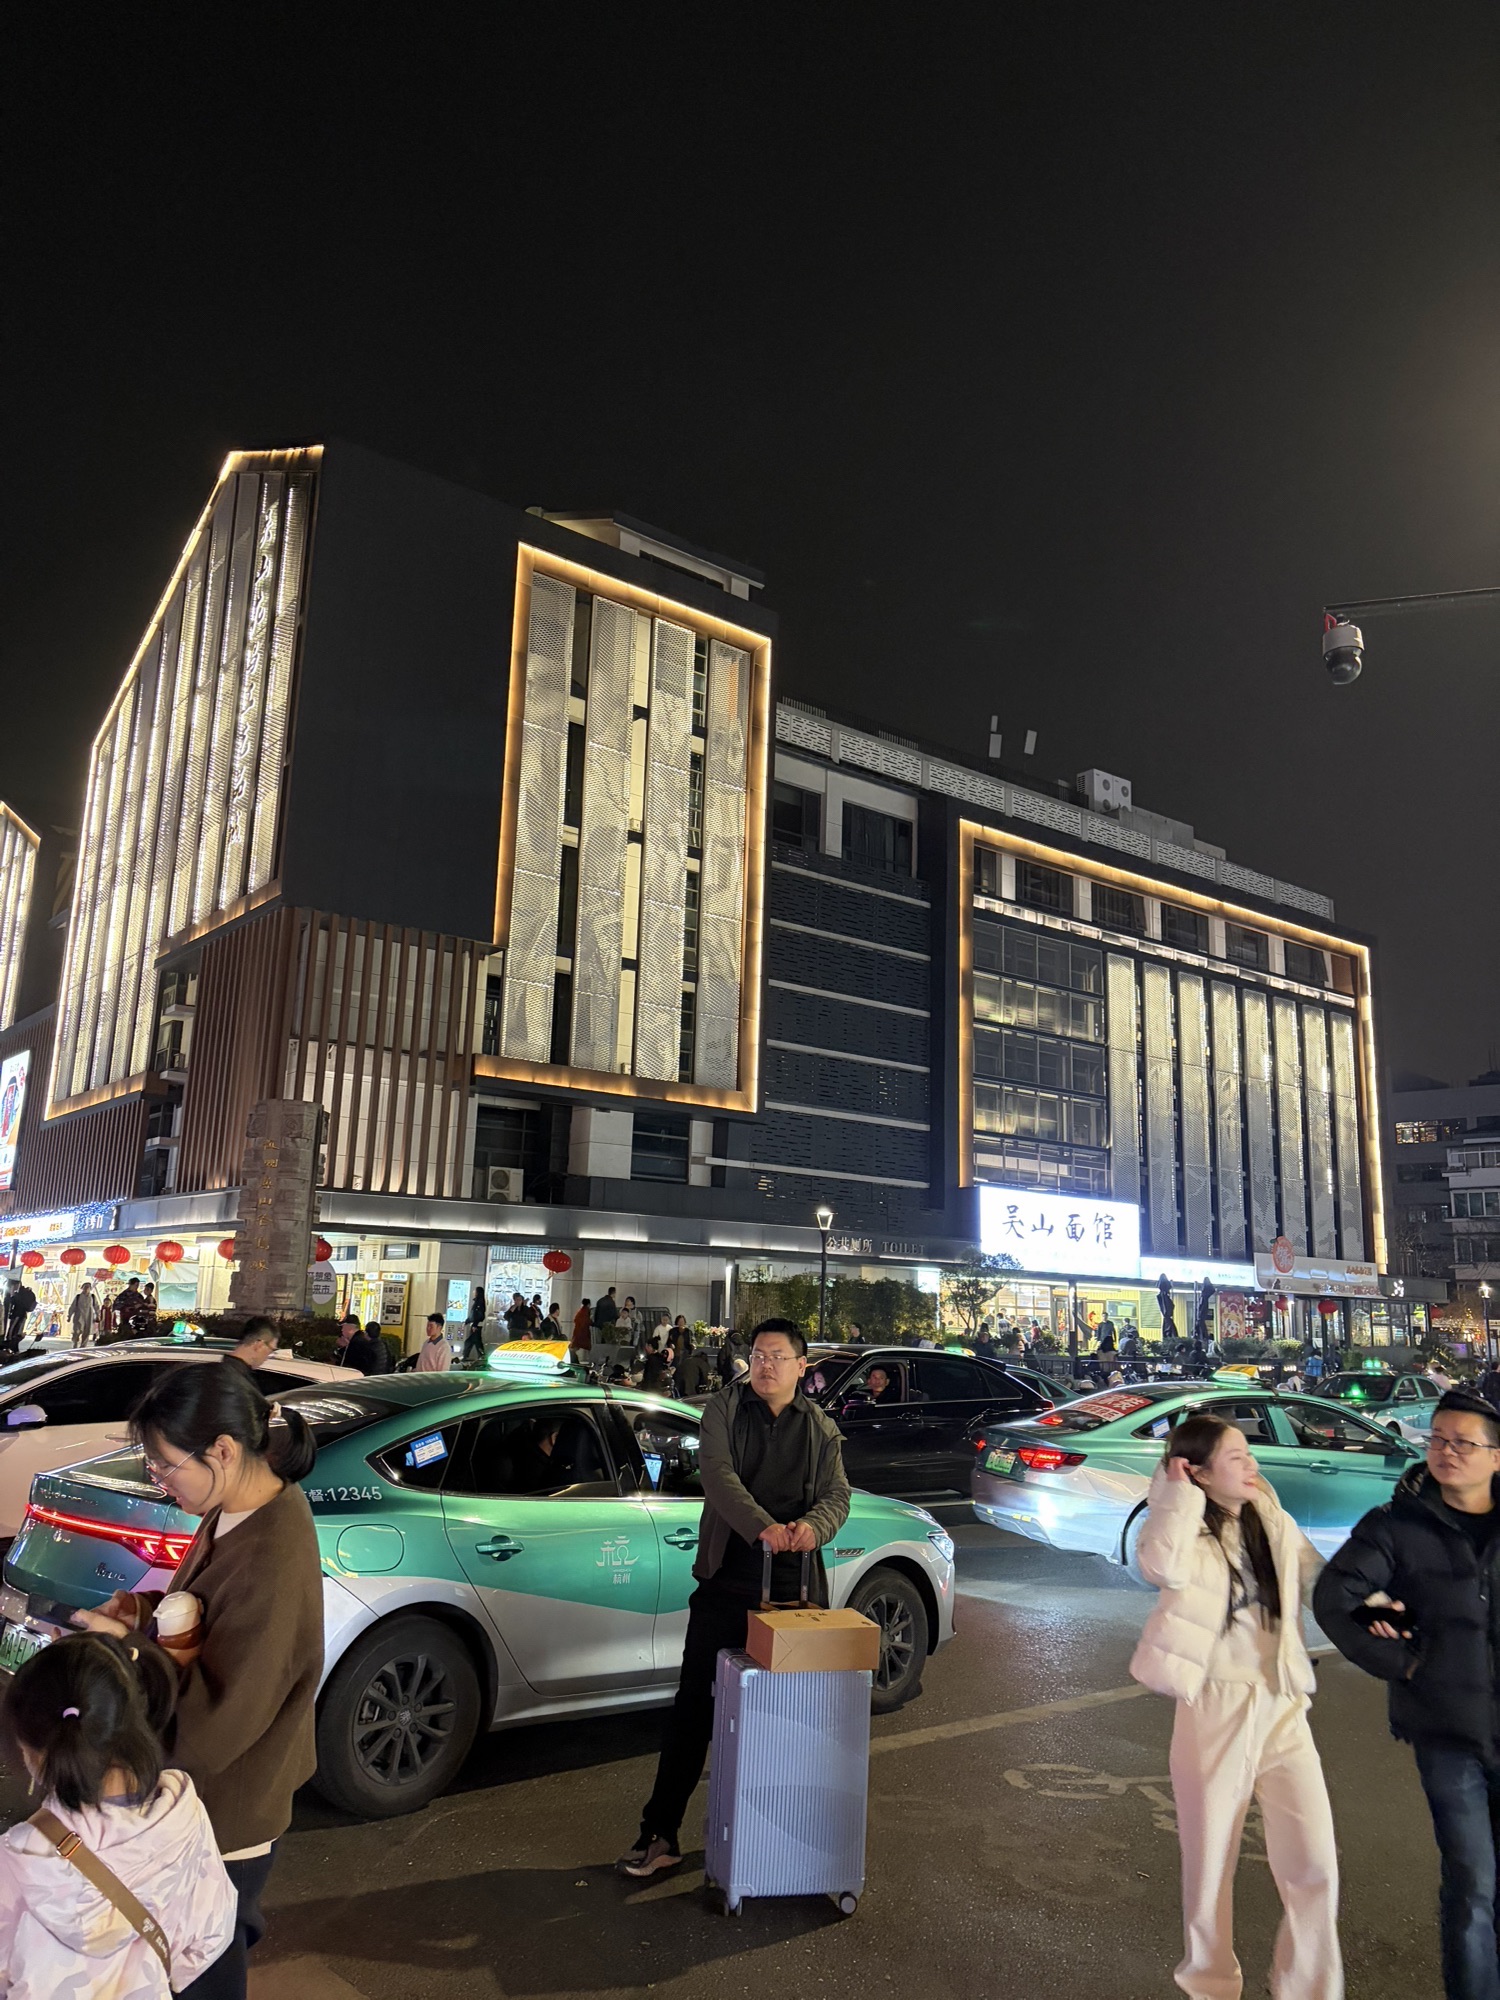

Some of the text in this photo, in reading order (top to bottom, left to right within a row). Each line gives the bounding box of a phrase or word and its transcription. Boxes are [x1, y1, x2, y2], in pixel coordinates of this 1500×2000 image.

[1002, 1204, 1115, 1249] 吴山面馆
[825, 1235, 926, 1256] 公共厕所 TOILET
[303, 1486, 383, 1503] 督:12345
[613, 1573, 631, 1585] 杭州
